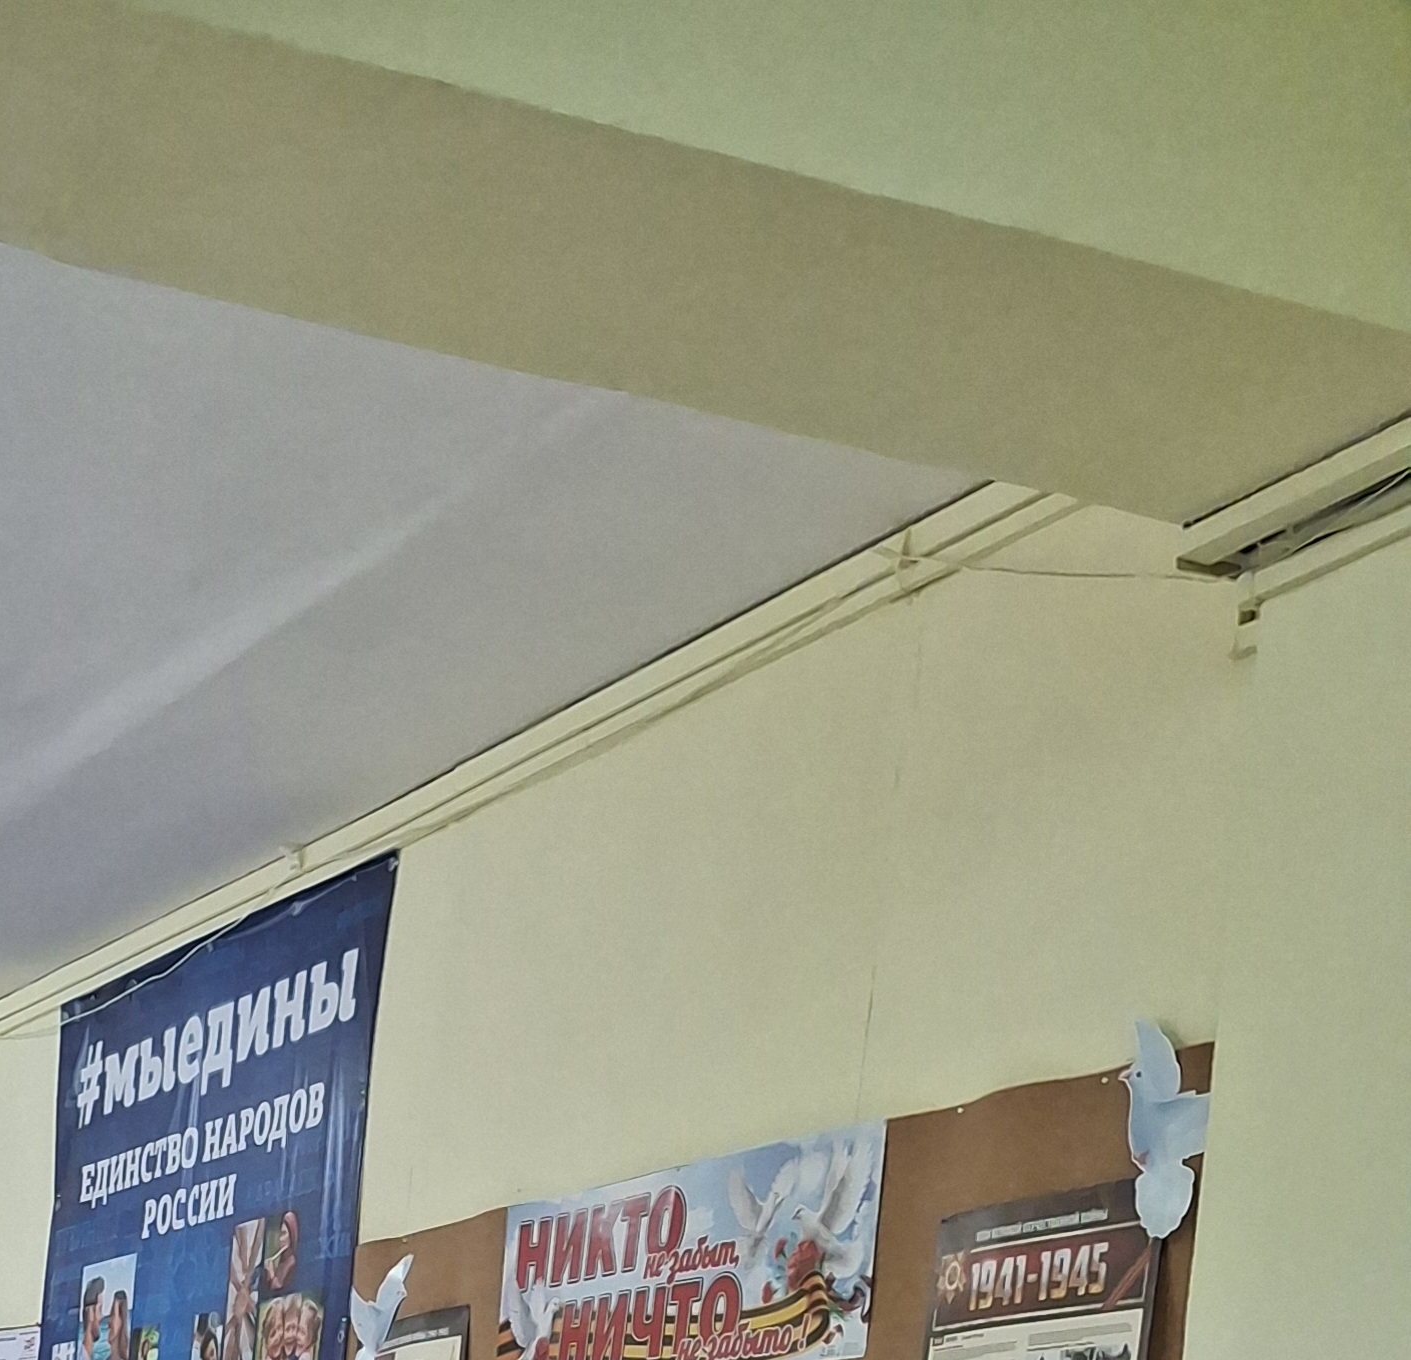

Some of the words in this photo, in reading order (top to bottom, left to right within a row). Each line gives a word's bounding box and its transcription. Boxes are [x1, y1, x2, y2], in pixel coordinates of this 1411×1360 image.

[79, 1127, 197, 1209] ЕДИНСТВО
[202, 1082, 325, 1162] НАРОДОВ
[141, 1173, 237, 1239] РОССИИ
[515, 1185, 687, 1292] НИКТО
[968, 1242, 1109, 1311] 1941-1945
